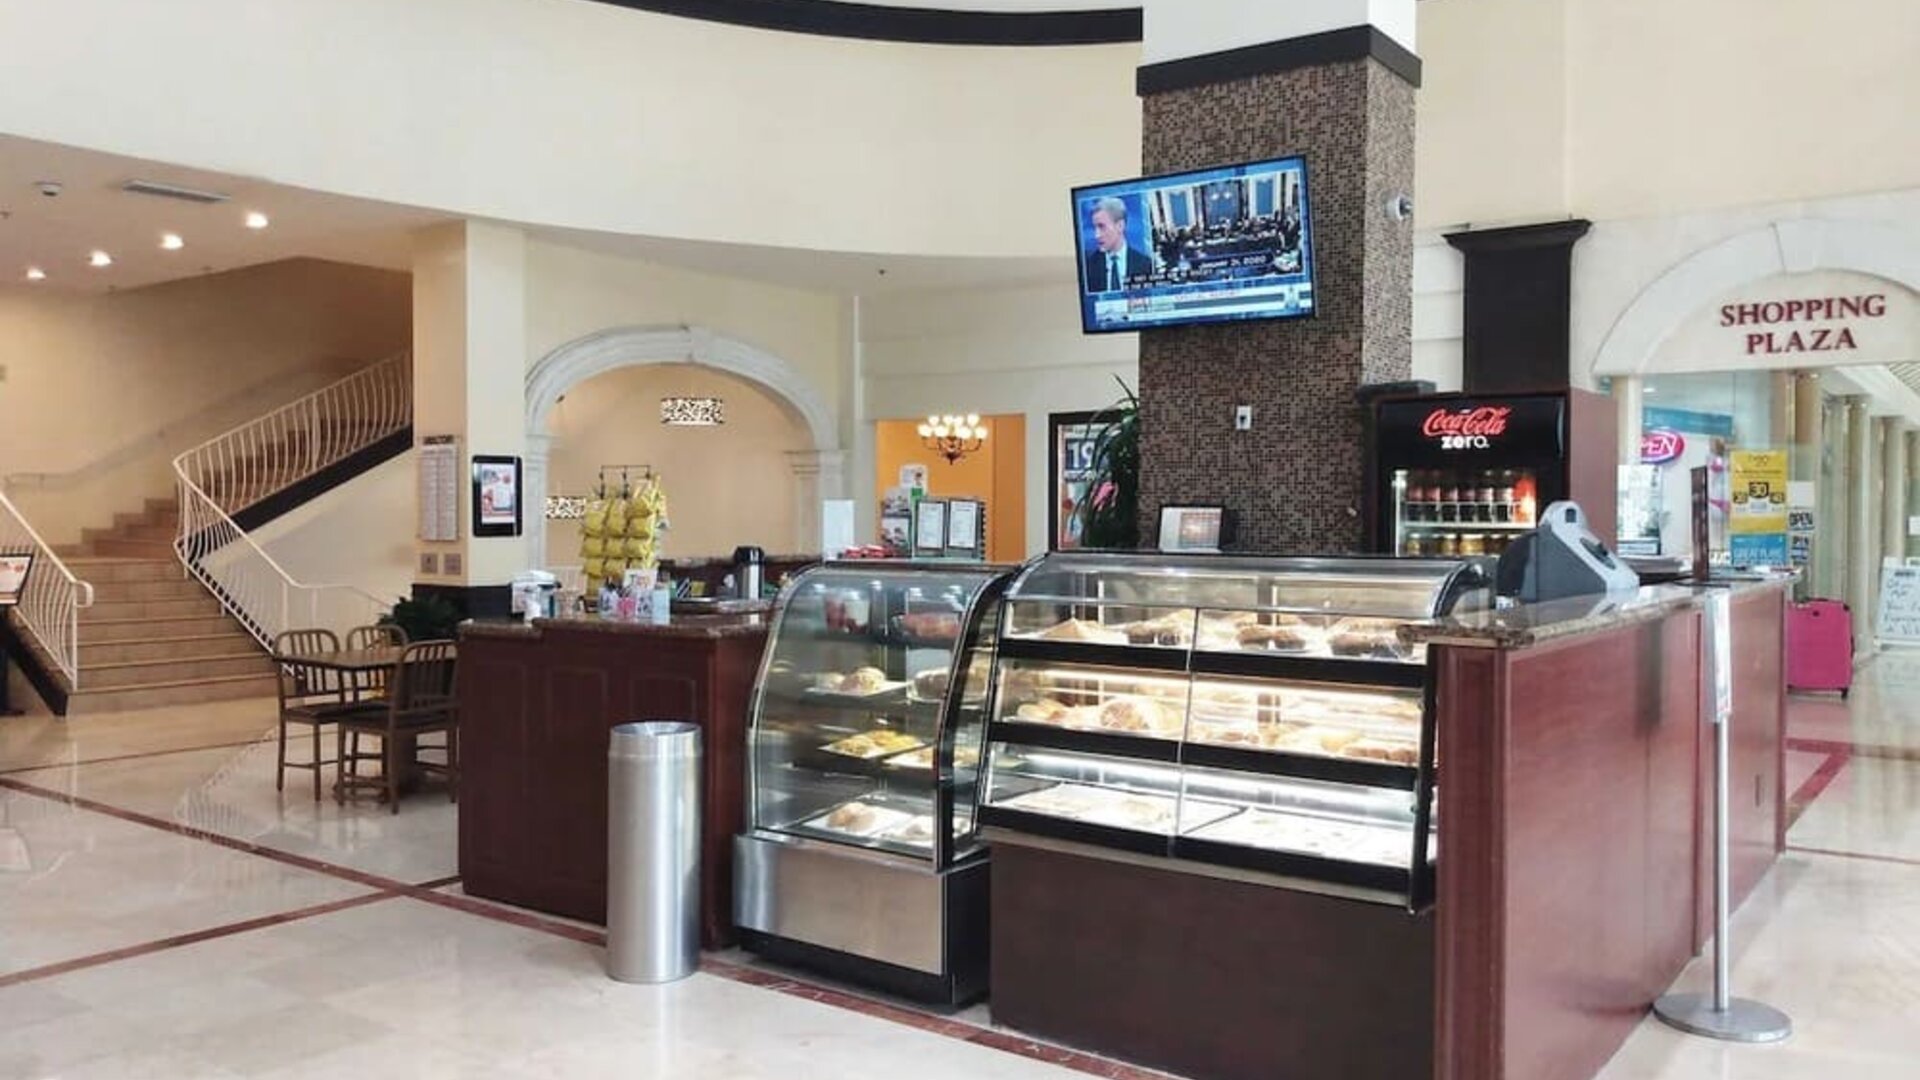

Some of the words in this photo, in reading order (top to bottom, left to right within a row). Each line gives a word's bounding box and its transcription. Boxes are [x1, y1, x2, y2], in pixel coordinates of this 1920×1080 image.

[1720, 294, 1886, 327] SHOPPING
[1746, 327, 1857, 354] PLAZA
[1423, 406, 1511, 437] Coca-Cola
